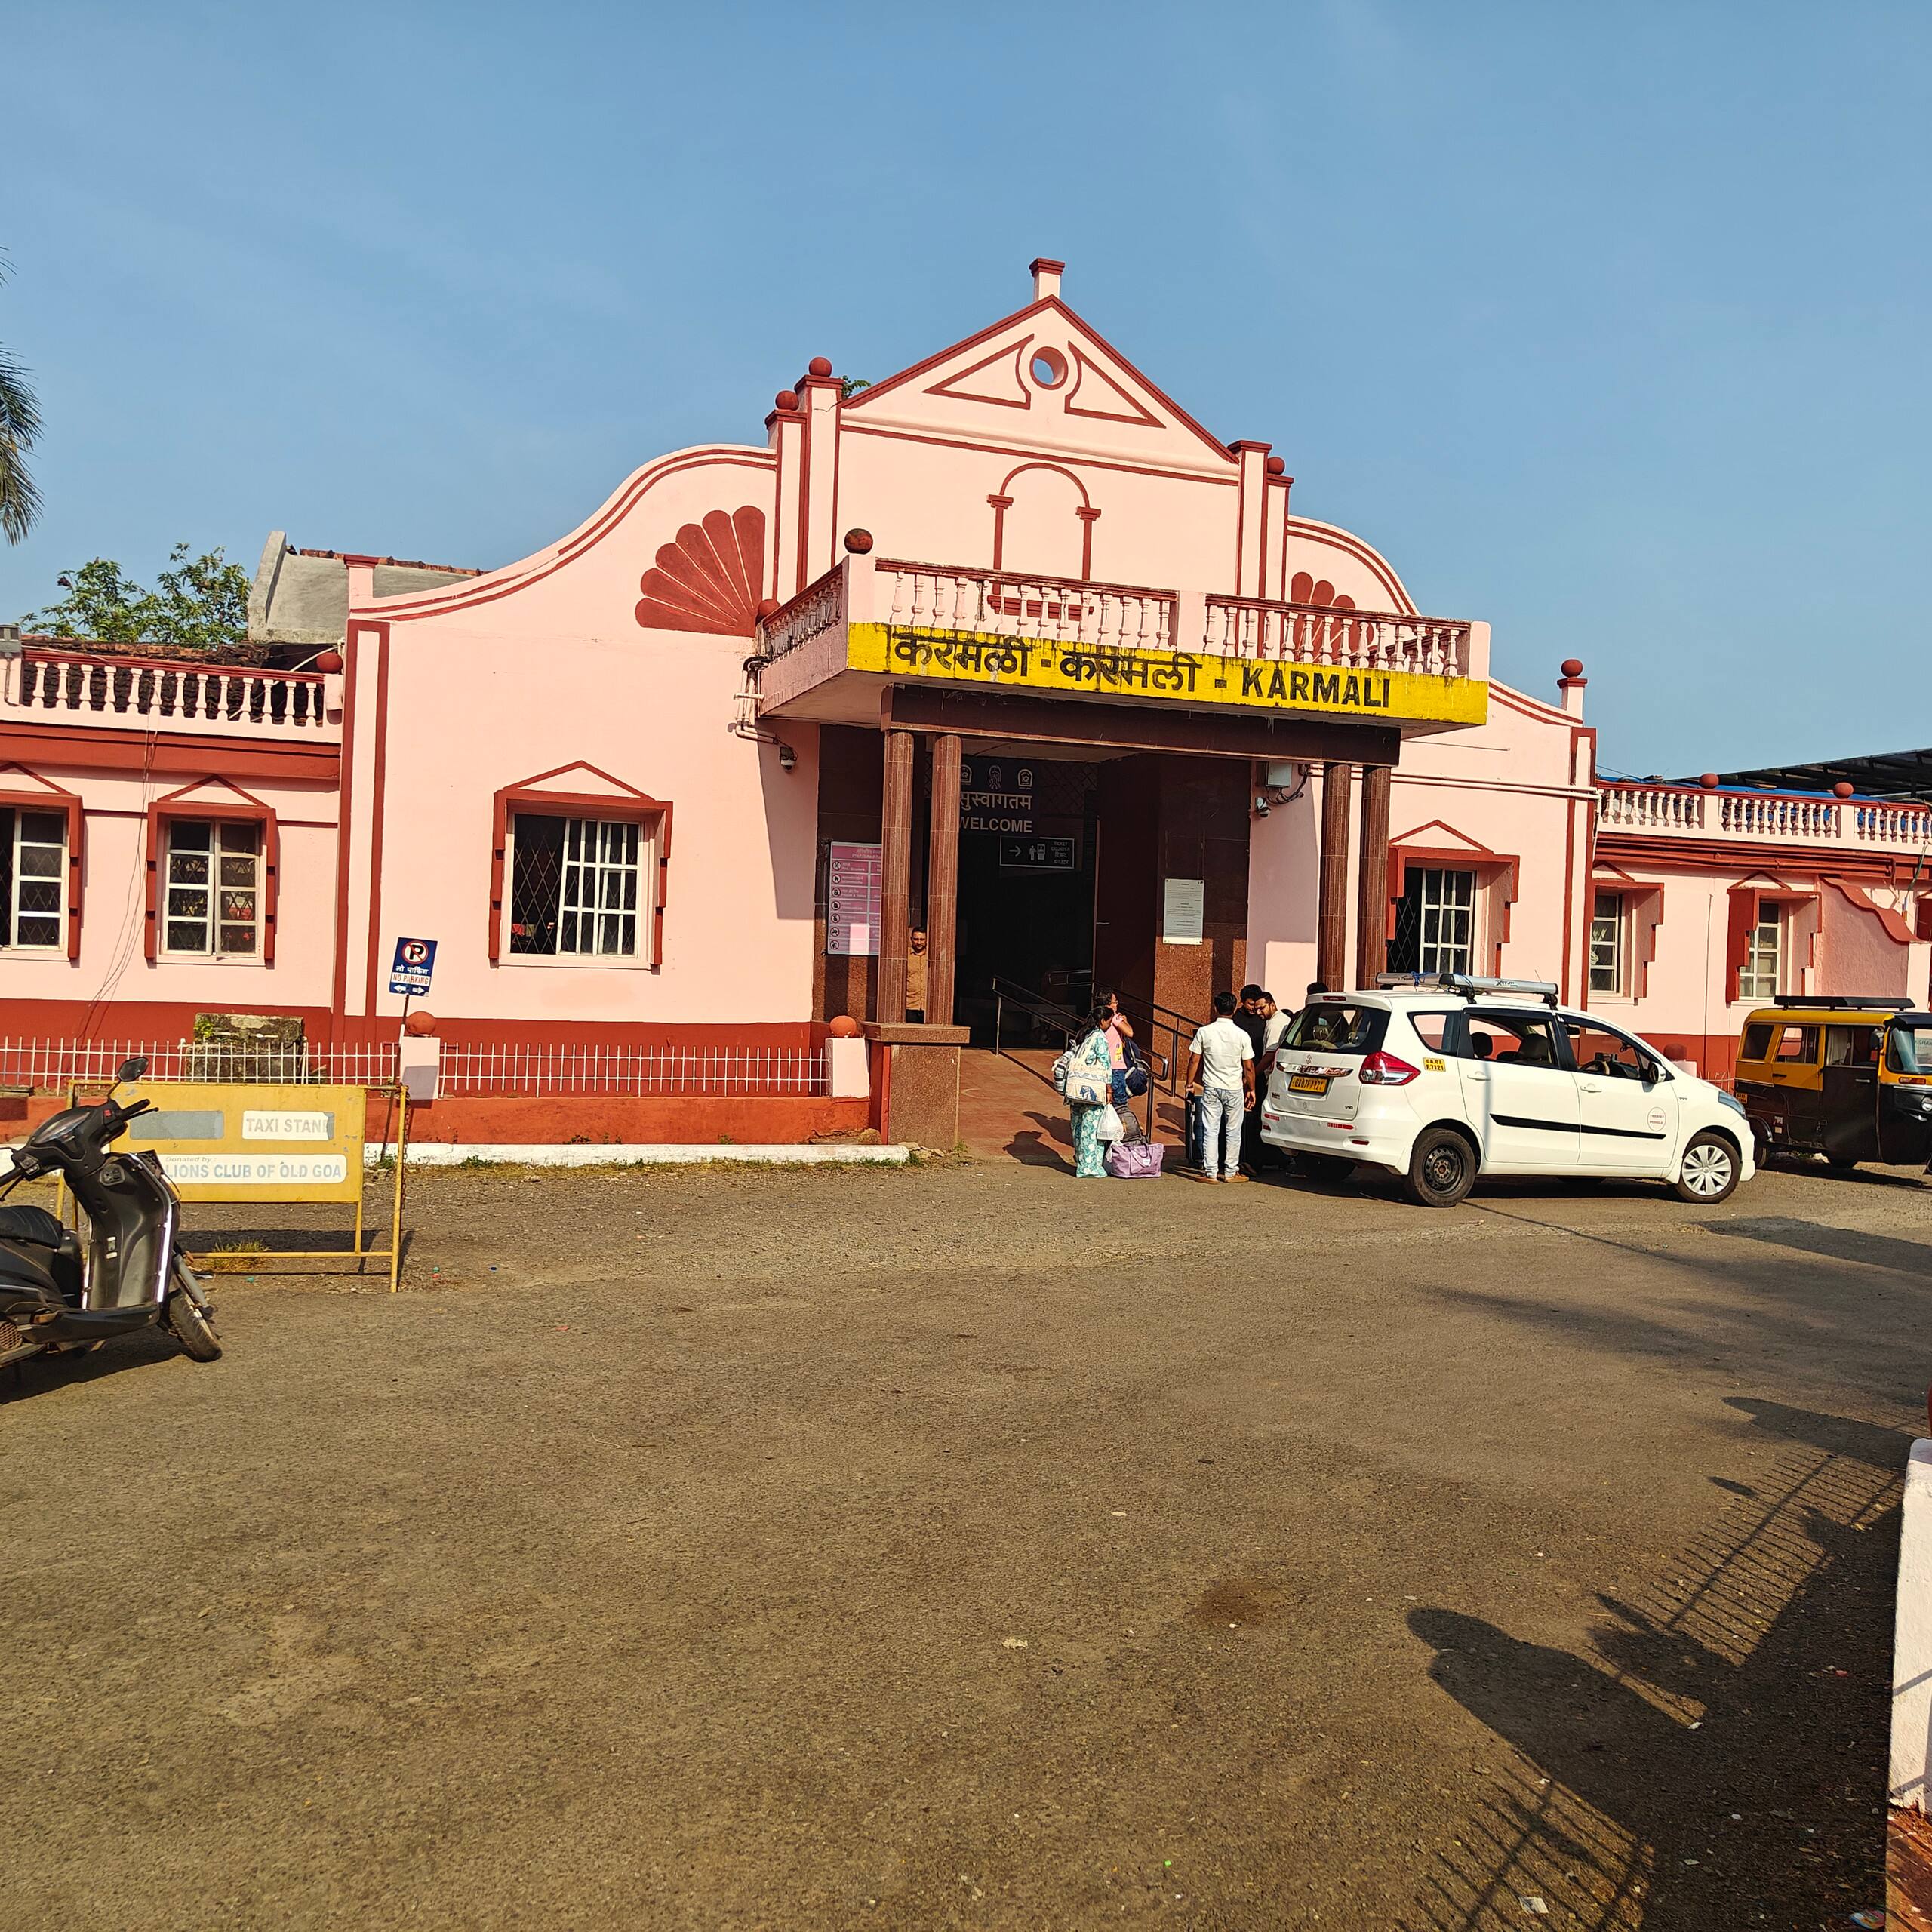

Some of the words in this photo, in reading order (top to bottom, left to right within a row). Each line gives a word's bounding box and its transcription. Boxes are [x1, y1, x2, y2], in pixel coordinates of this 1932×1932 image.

[892, 633, 1033, 677] करमळी
[1060, 651, 1203, 692] करमली
[1241, 666, 1390, 708] KARMALI
[403, 975, 429, 984] PARKING
[246, 1118, 278, 1132] TAXI
[165, 1164, 209, 1178] LIONS
[214, 1164, 251, 1178] CLUB
[257, 1164, 275, 1178] OF
[280, 1164, 307, 1178] OLD
[312, 1164, 342, 1178] GOA
